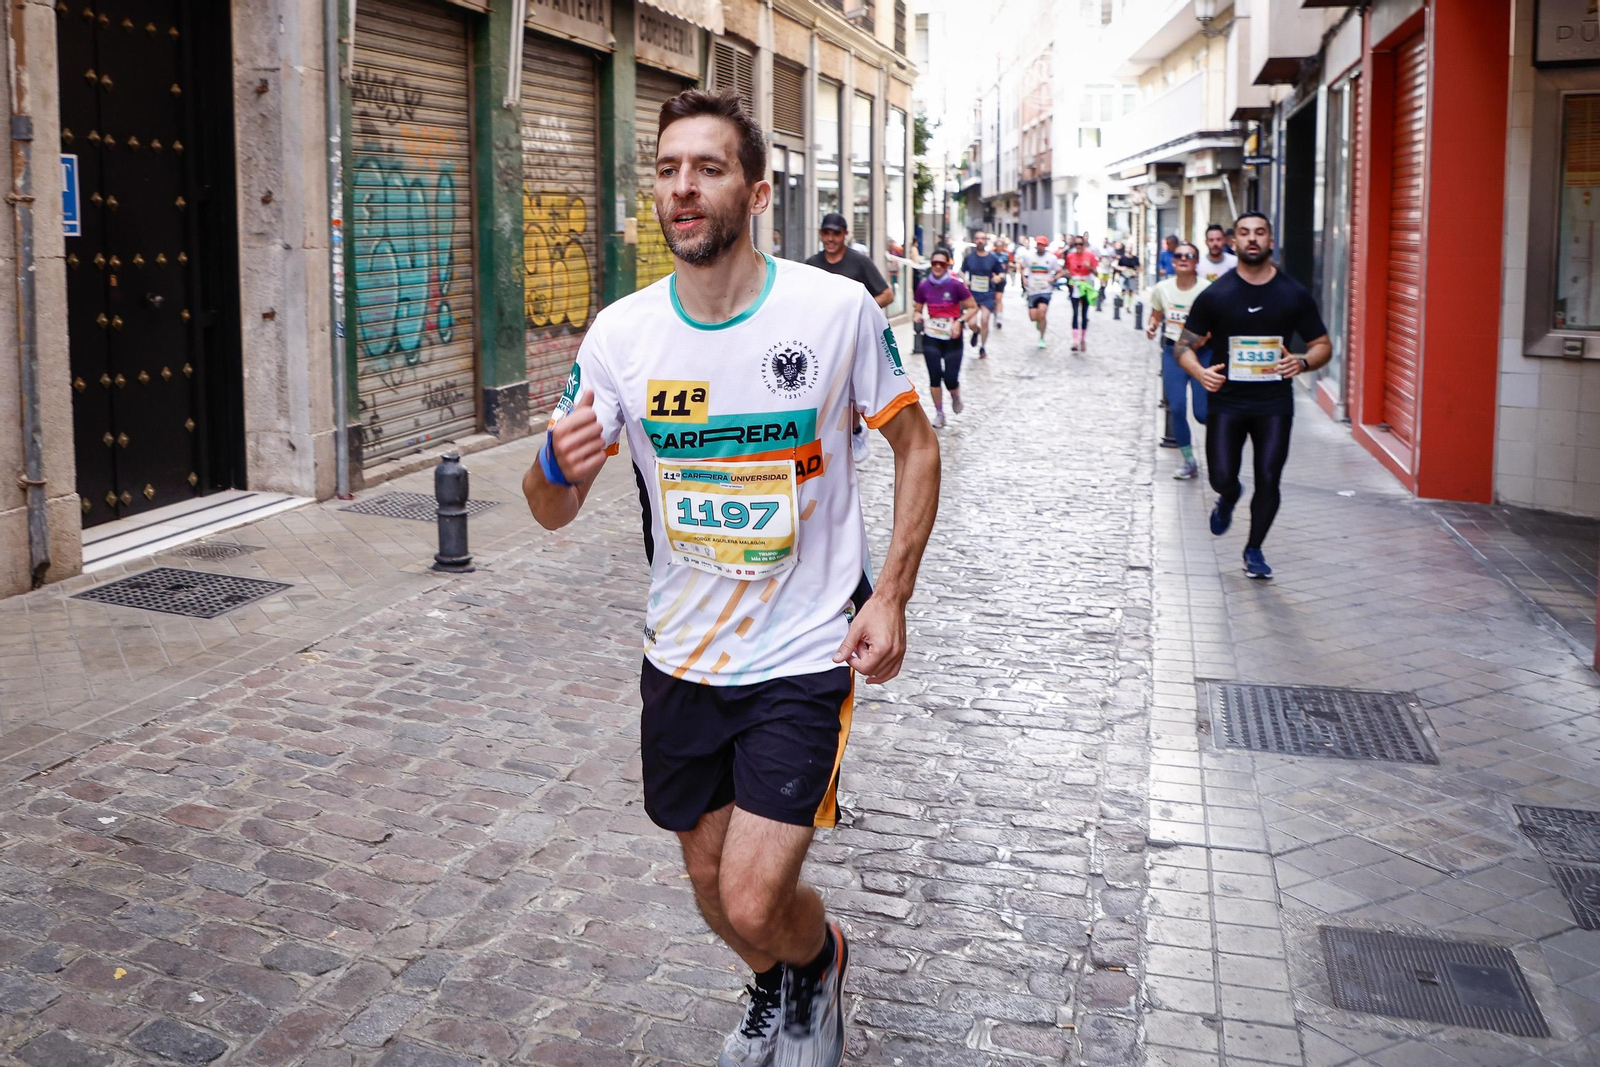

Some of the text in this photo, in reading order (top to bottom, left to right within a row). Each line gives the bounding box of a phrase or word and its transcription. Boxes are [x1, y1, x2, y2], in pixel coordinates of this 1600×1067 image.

[761, 341, 783, 395] UNIVERSITAS
[1236, 350, 1276, 362] 1313
[650, 387, 707, 417] 11ª
[650, 421, 799, 450] CARRERA
[663, 471, 788, 482] 11ª CARRERA UNIVERSIDAD
[676, 497, 780, 530] 1197
